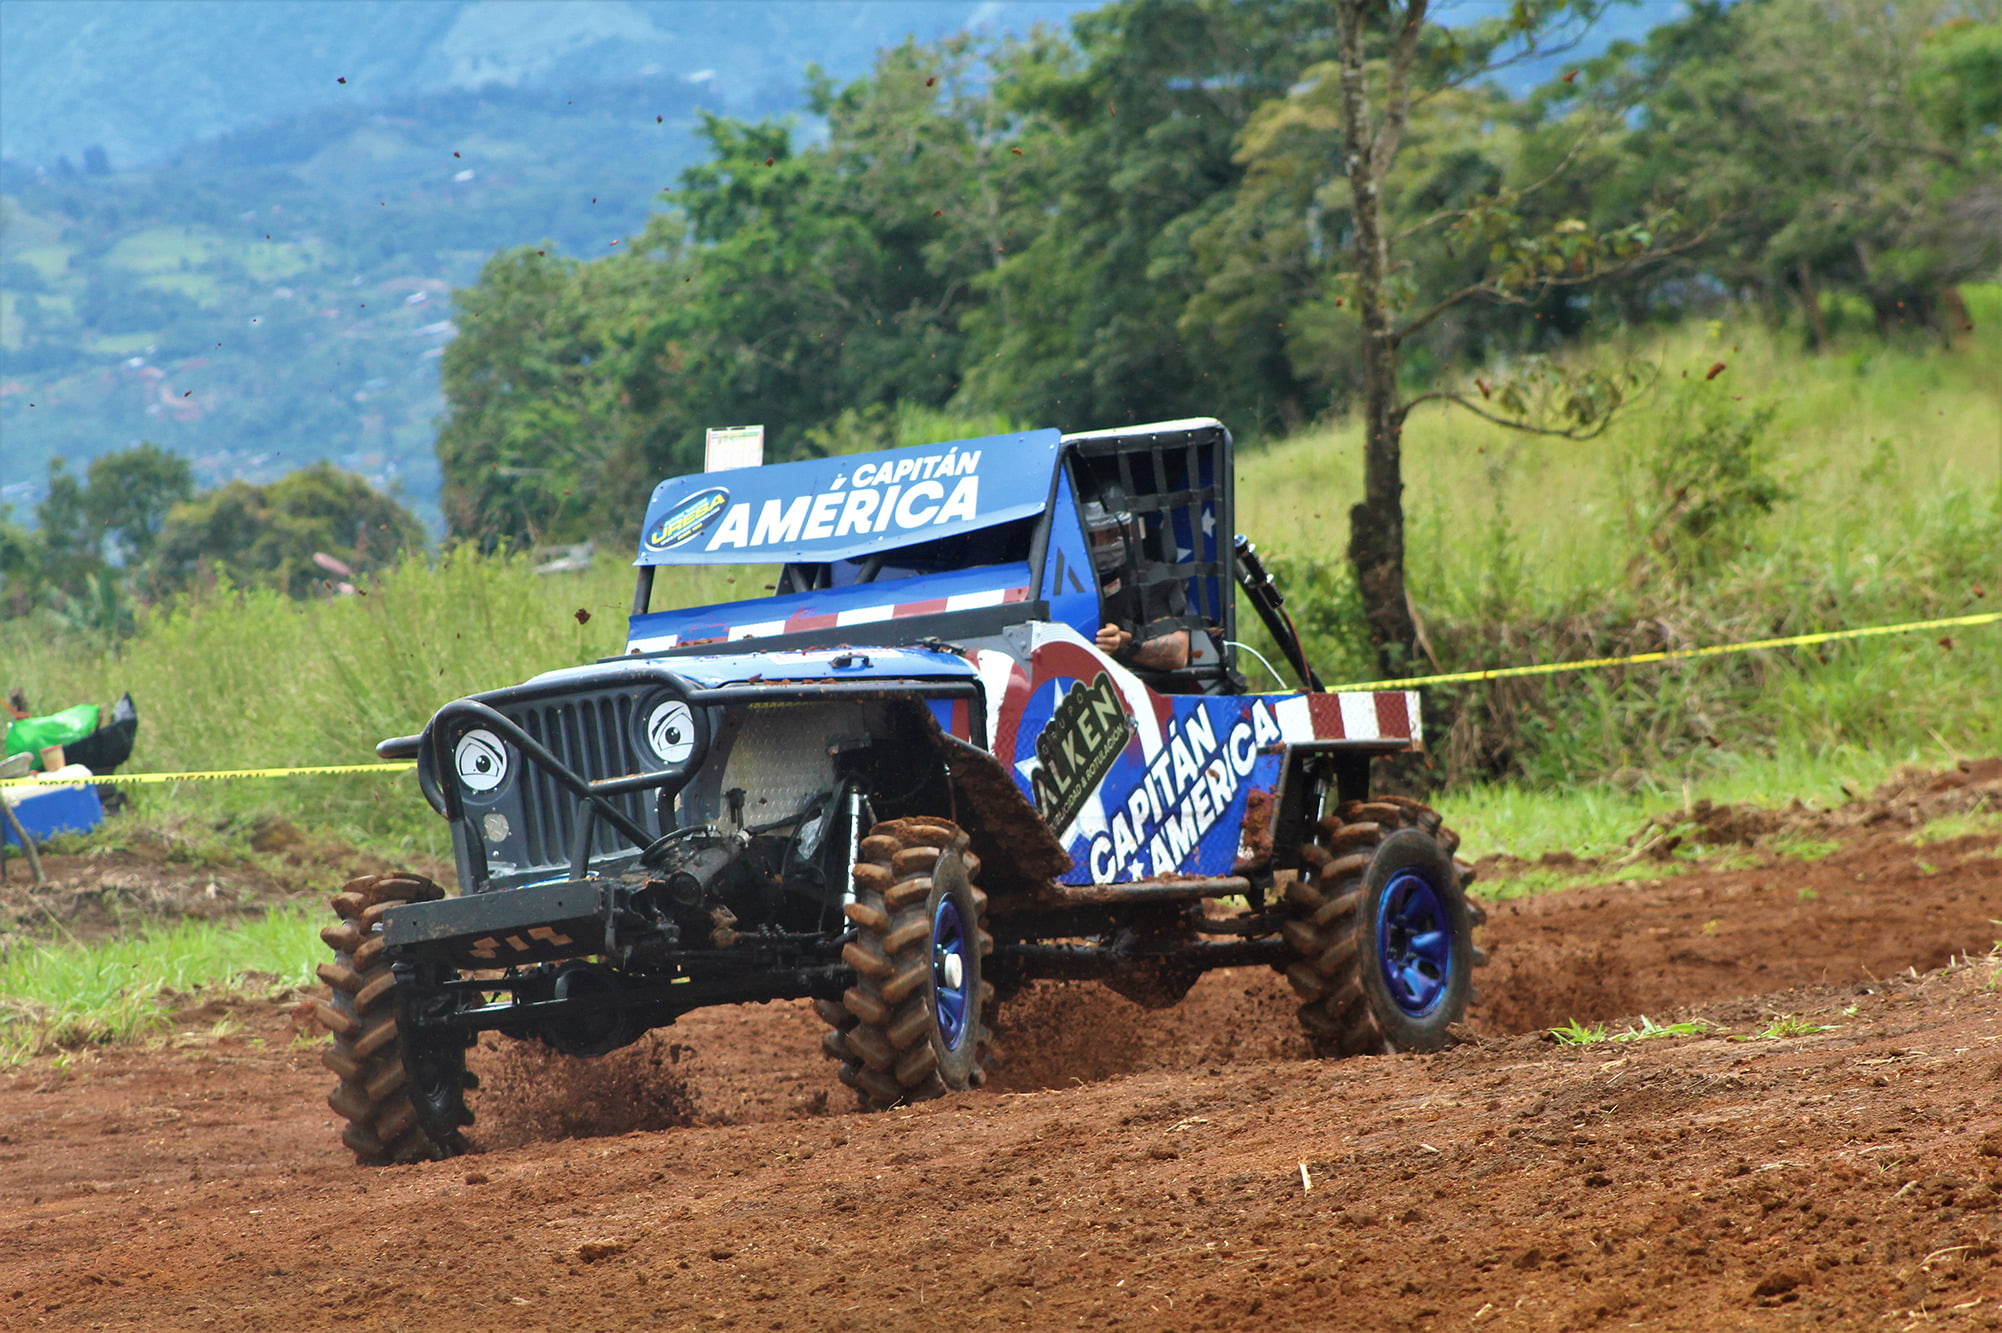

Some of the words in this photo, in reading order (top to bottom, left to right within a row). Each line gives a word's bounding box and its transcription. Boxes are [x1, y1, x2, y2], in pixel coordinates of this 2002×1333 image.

[704, 475, 980, 552] AMÉRICA
[851, 446, 982, 488] CAPITÁN
[1090, 702, 1218, 885] CAPITÁN
[1150, 698, 1281, 879] AMERICA
